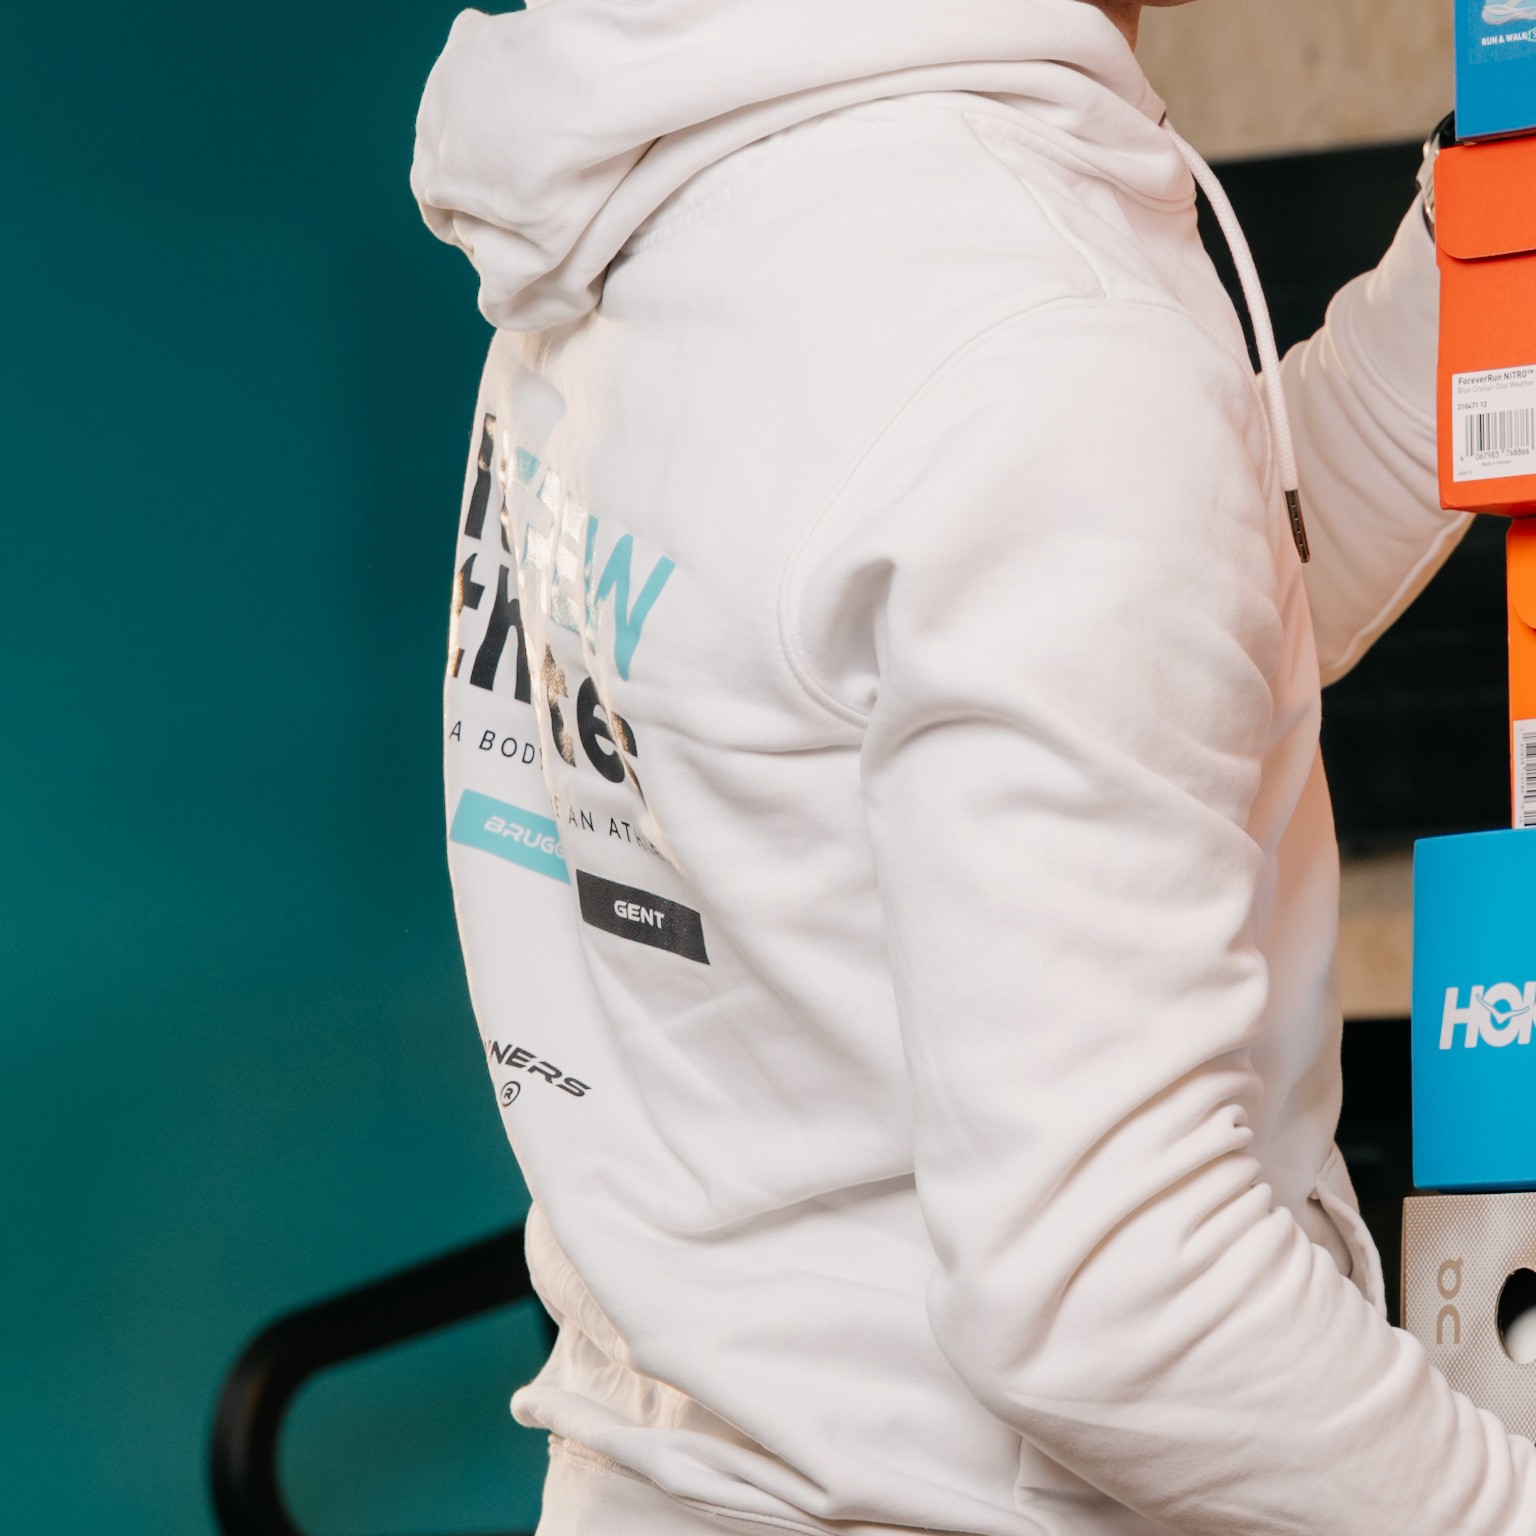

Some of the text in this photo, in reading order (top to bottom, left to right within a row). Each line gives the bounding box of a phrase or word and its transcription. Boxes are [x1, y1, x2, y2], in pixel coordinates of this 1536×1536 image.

[1481, 36, 1498, 46] RUN
[1498, 35, 1505, 44] &
[1506, 31, 1527, 43] WALK
[1458, 374, 1502, 384] ForeverRun
[450, 721, 543, 770] A BOD
[568, 809, 594, 832] AN
[614, 900, 665, 929] GENT
[486, 1039, 592, 1097] NERS
